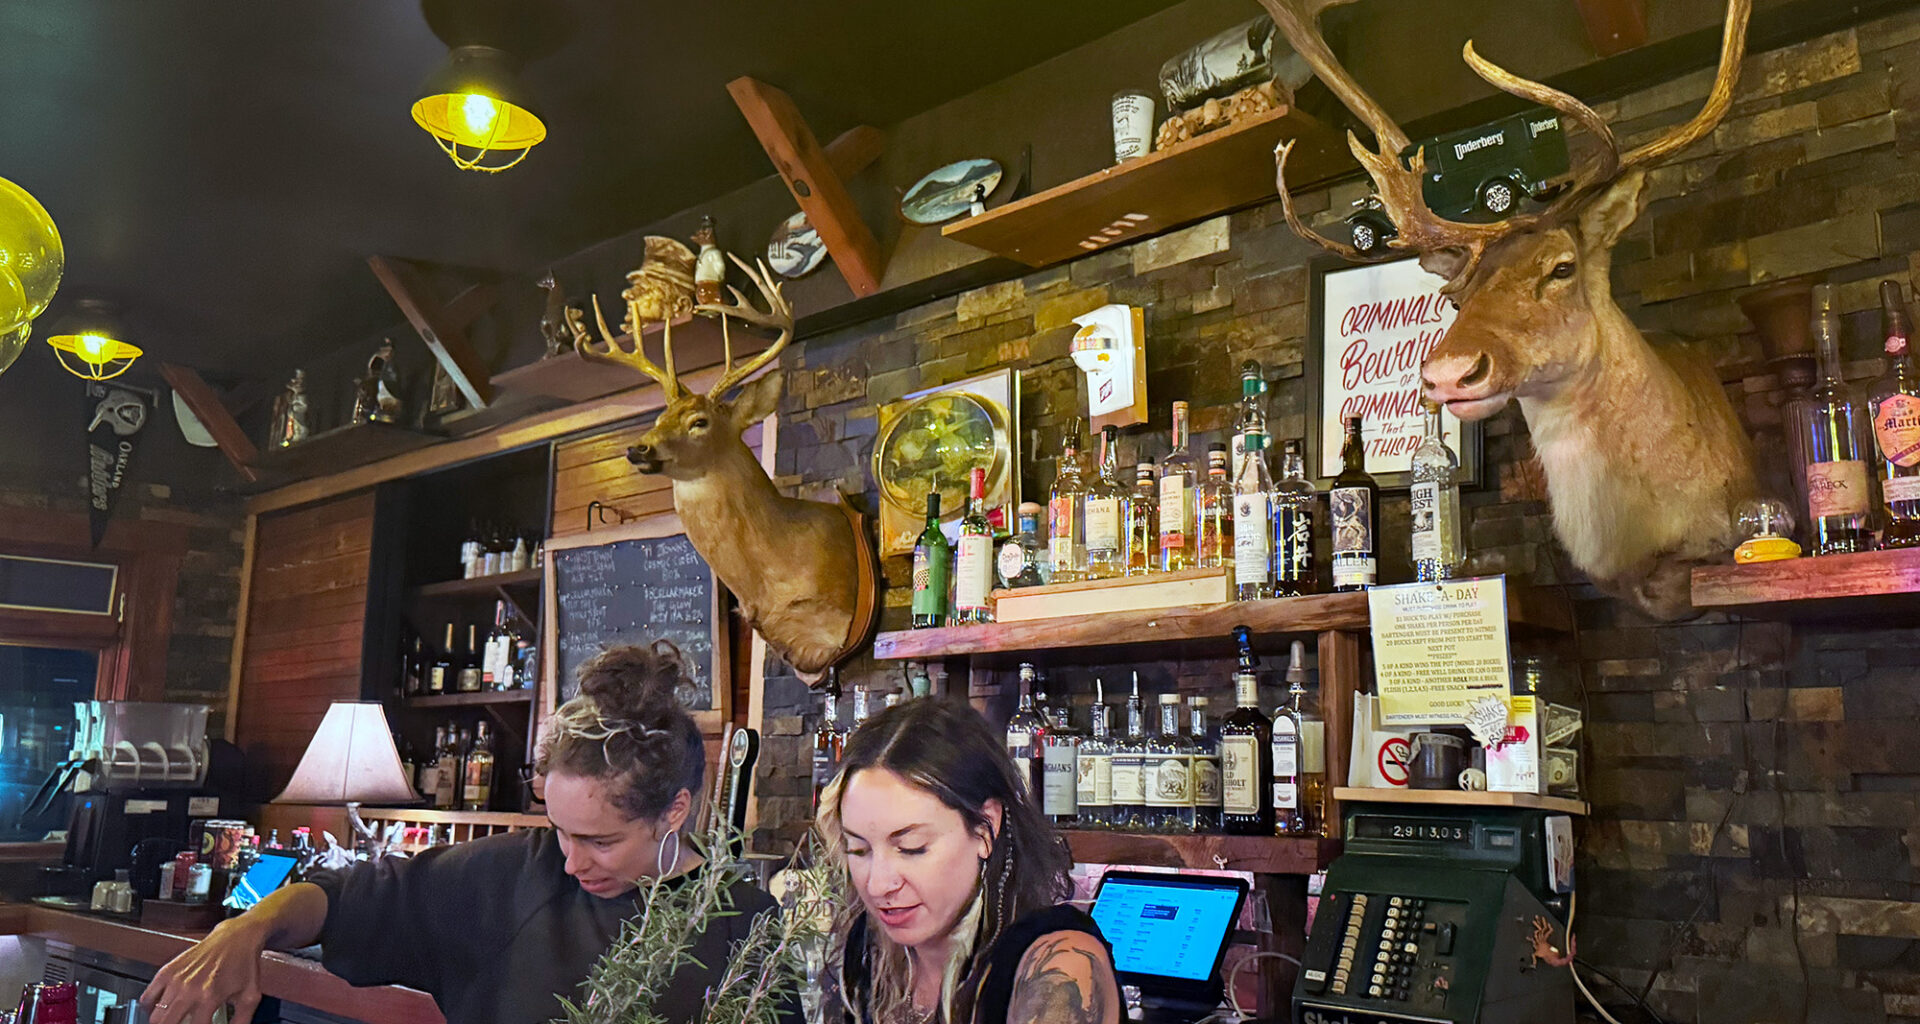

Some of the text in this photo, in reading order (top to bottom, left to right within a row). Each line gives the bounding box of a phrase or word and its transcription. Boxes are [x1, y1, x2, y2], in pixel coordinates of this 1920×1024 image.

[1530, 117, 1558, 138] Underberg
[1454, 130, 1504, 160] Underberg
[1340, 293, 1449, 338] CRIMINALS
[1340, 327, 1450, 391] Beware
[1400, 374, 1414, 388] OF
[1340, 389, 1426, 426] CRIMINAL
[1381, 420, 1406, 434] That
[1372, 436, 1406, 459] THIS
[1394, 591, 1433, 606] SHAKE
[1455, 587, 1479, 601] DAY
[1381, 631, 1414, 639] BARTENDER
[1474, 704, 1505, 726] SHAKE
